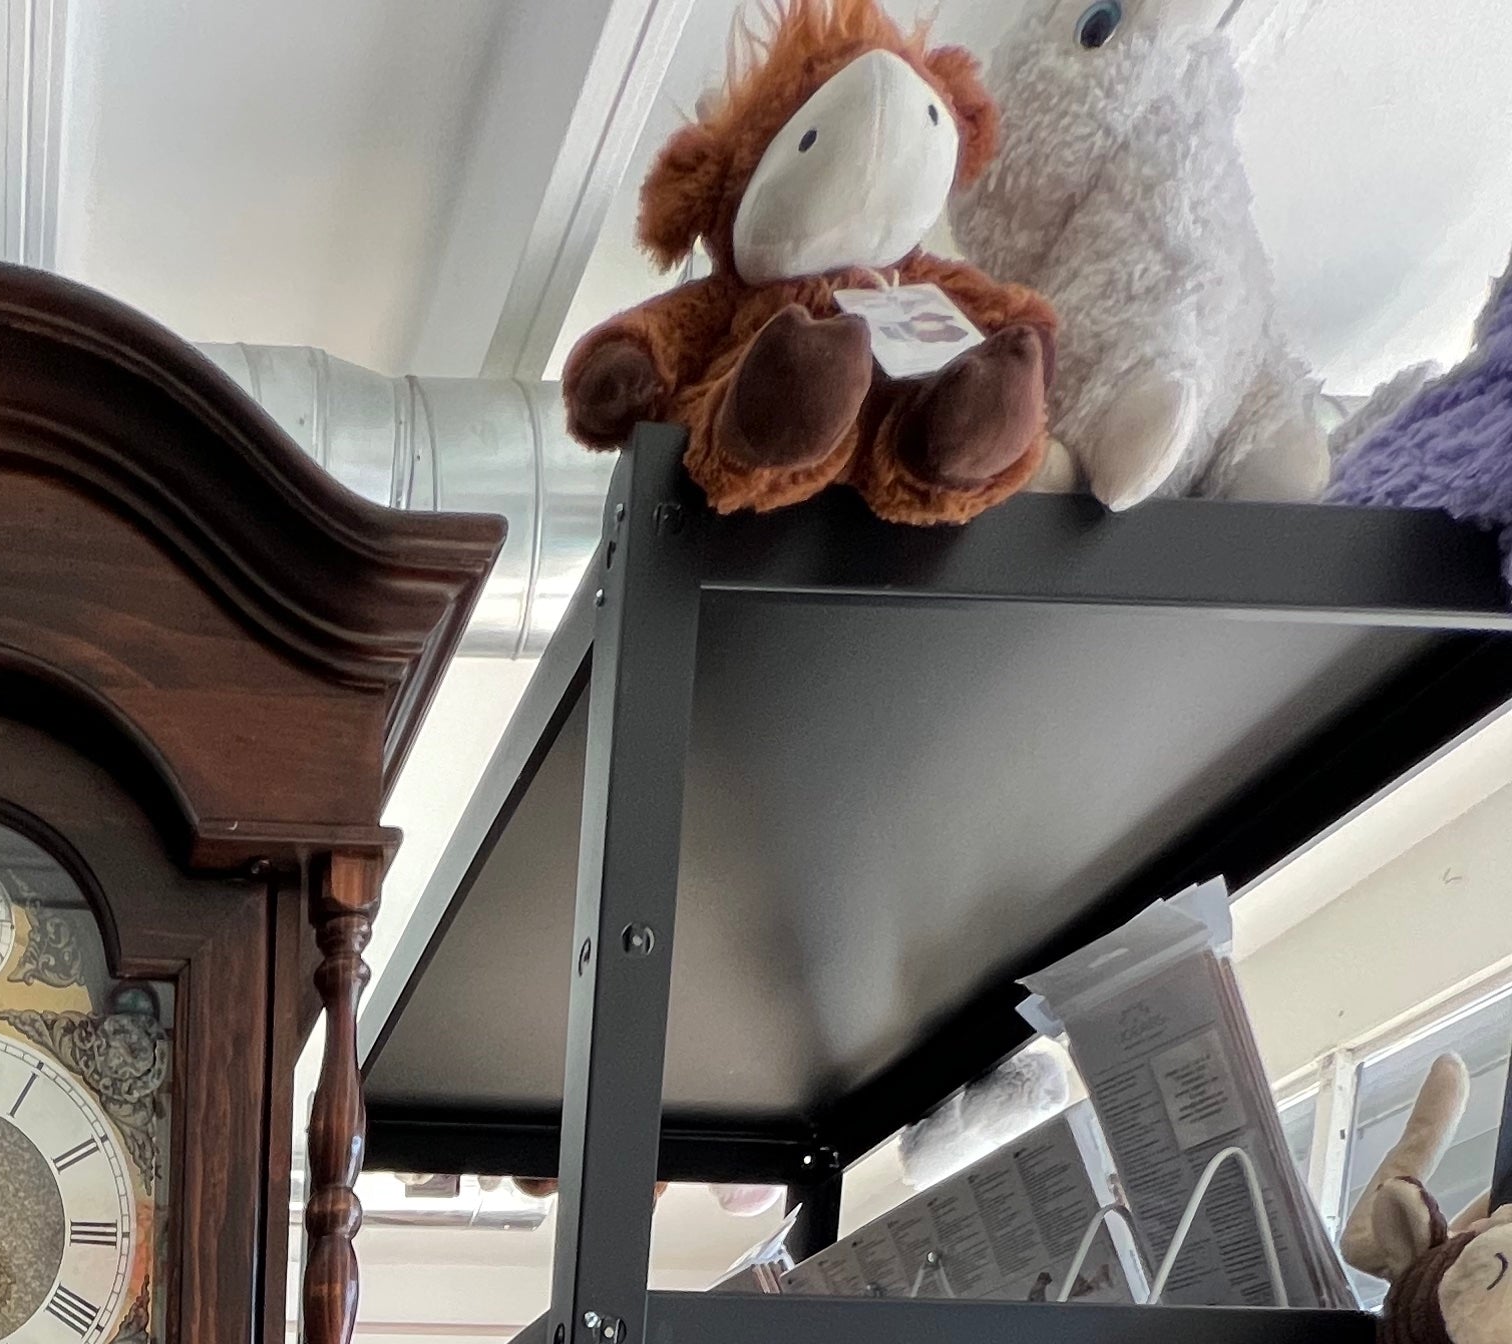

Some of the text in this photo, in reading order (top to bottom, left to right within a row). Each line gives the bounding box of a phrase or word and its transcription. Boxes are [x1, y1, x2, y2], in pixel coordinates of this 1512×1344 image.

[9, 1073, 39, 1117] I
[53, 1136, 100, 1172] II
[70, 1219, 118, 1249] III
